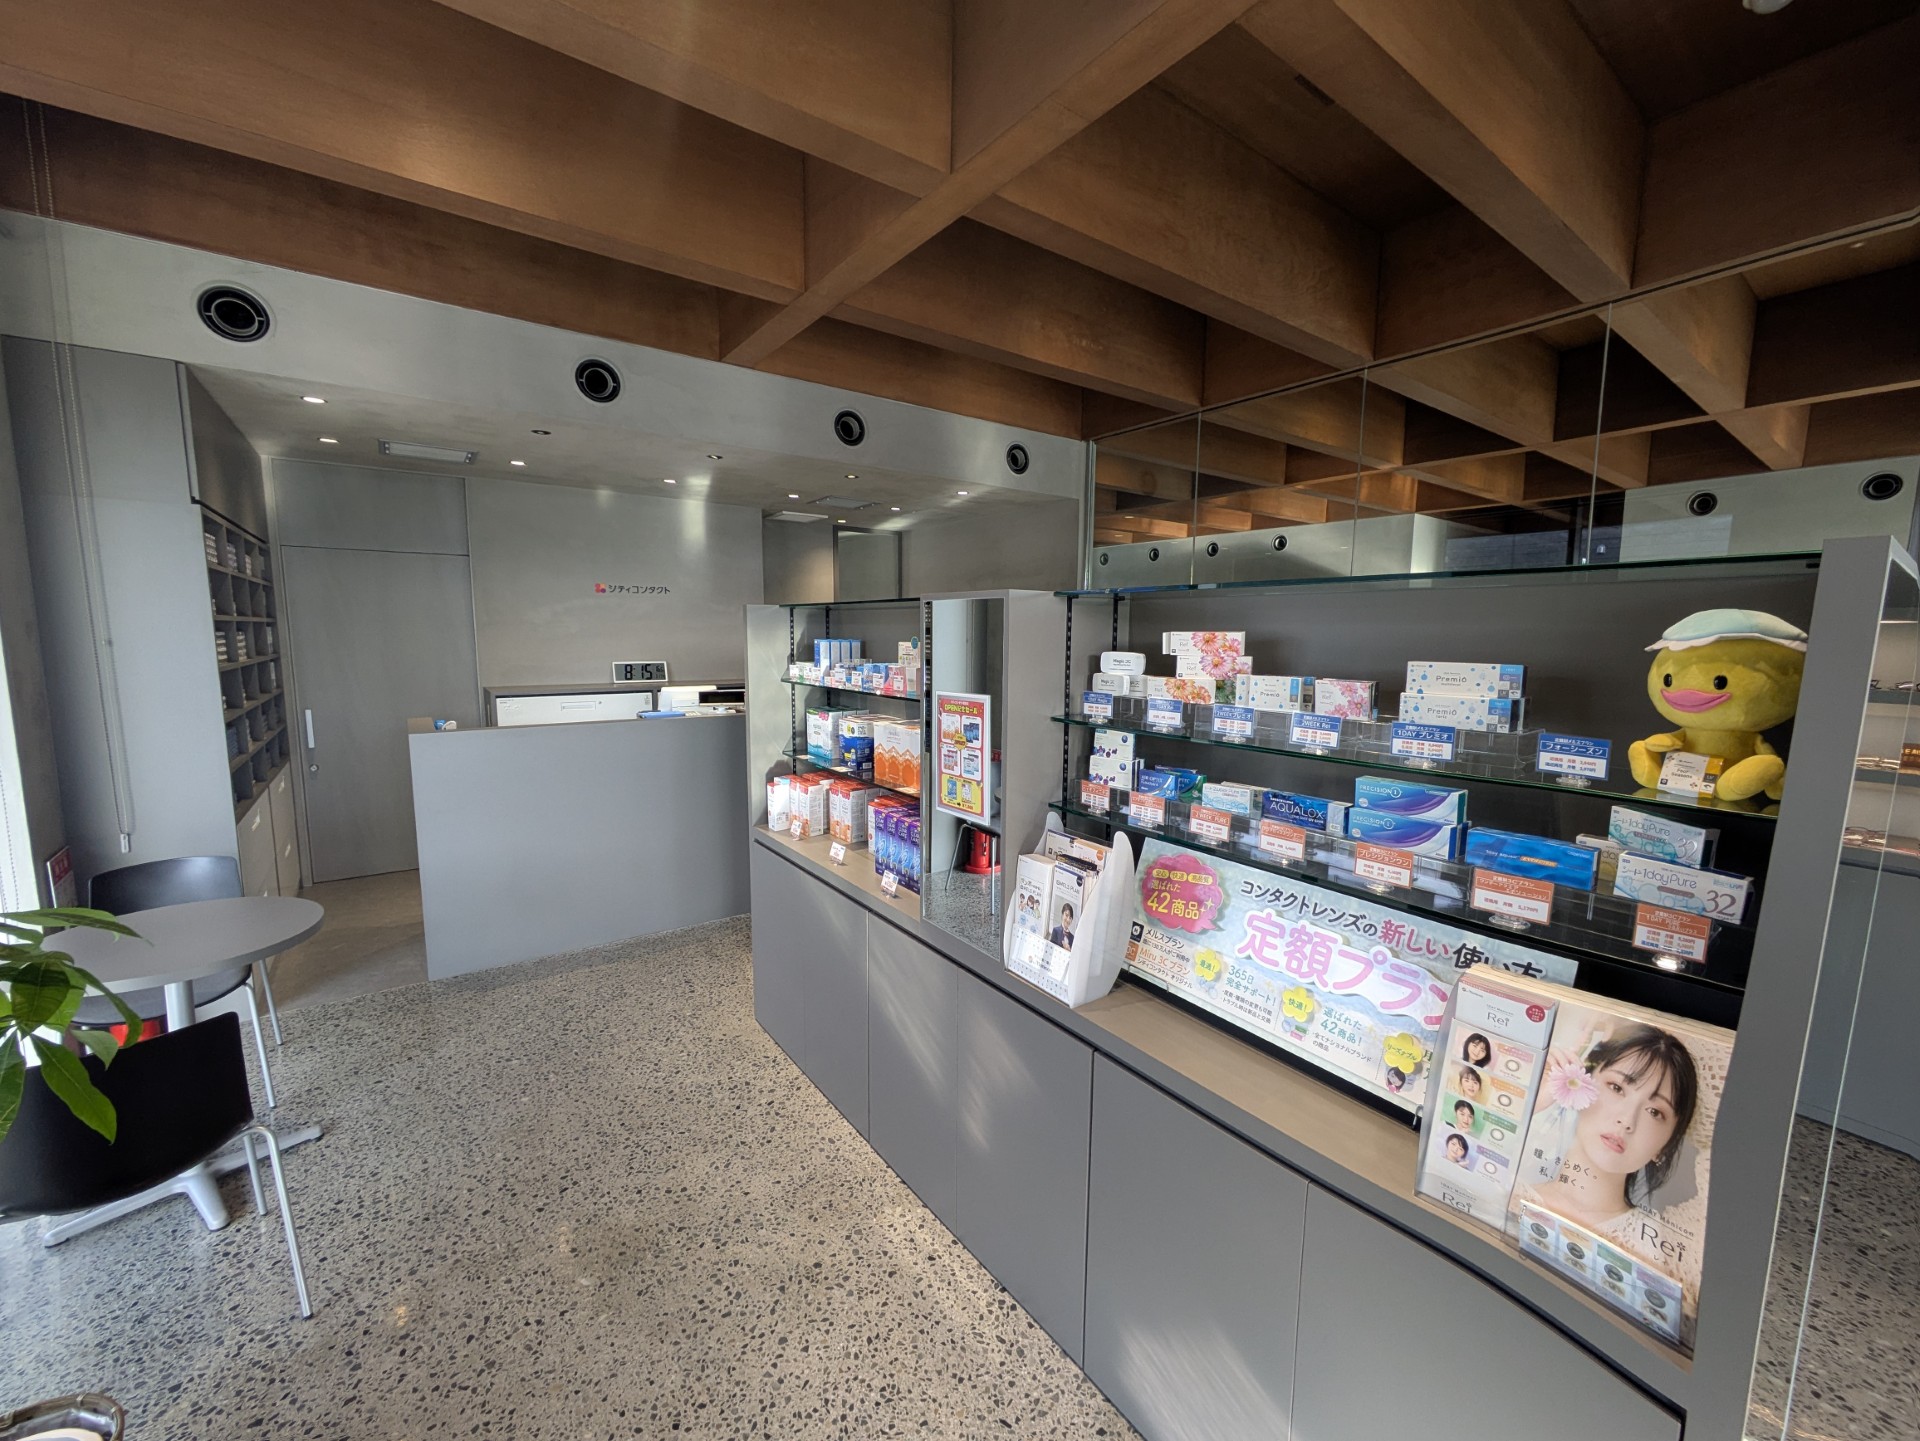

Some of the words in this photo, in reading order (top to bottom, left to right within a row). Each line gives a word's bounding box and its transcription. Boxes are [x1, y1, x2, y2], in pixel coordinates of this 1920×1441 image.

[608, 584, 670, 594] シティコンタクト
[624, 664, 652, 680] 8:15
[1419, 732, 1448, 740] プレミオ
[1546, 742, 1603, 755] フォーシーズン
[1360, 784, 1392, 794] PRECISION
[1270, 802, 1324, 820] AQUALOX
[1629, 818, 1670, 836] 1dayPure
[1359, 850, 1409, 866] プレシジョンワン
[1678, 837, 1698, 862] 32
[1151, 880, 1181, 892] 選ばれた
[1644, 868, 1697, 889] 1dayPure
[1148, 891, 1200, 920] 42商品
[1706, 890, 1737, 917] 32
[1146, 928, 1184, 949] メルスプラン
[1140, 947, 1157, 961] Miru
[1158, 956, 1168, 967] 3C
[1170, 961, 1190, 976] プラン
[1138, 959, 1169, 978] シティコンタクト
[1170, 975, 1193, 989] オリジナル
[1228, 965, 1254, 985] 365日
[1322, 1006, 1363, 1031] 選ばれた
[1487, 1012, 1510, 1027] Rei
[1312, 1040, 1330, 1052] の商品
[1539, 1166, 1584, 1190] 私、輝く。
[1442, 1192, 1472, 1213] Rei
[1638, 1202, 1657, 1218] 1DAY
[1659, 1214, 1695, 1238] Menicon
[1640, 1222, 1686, 1262] Rei
